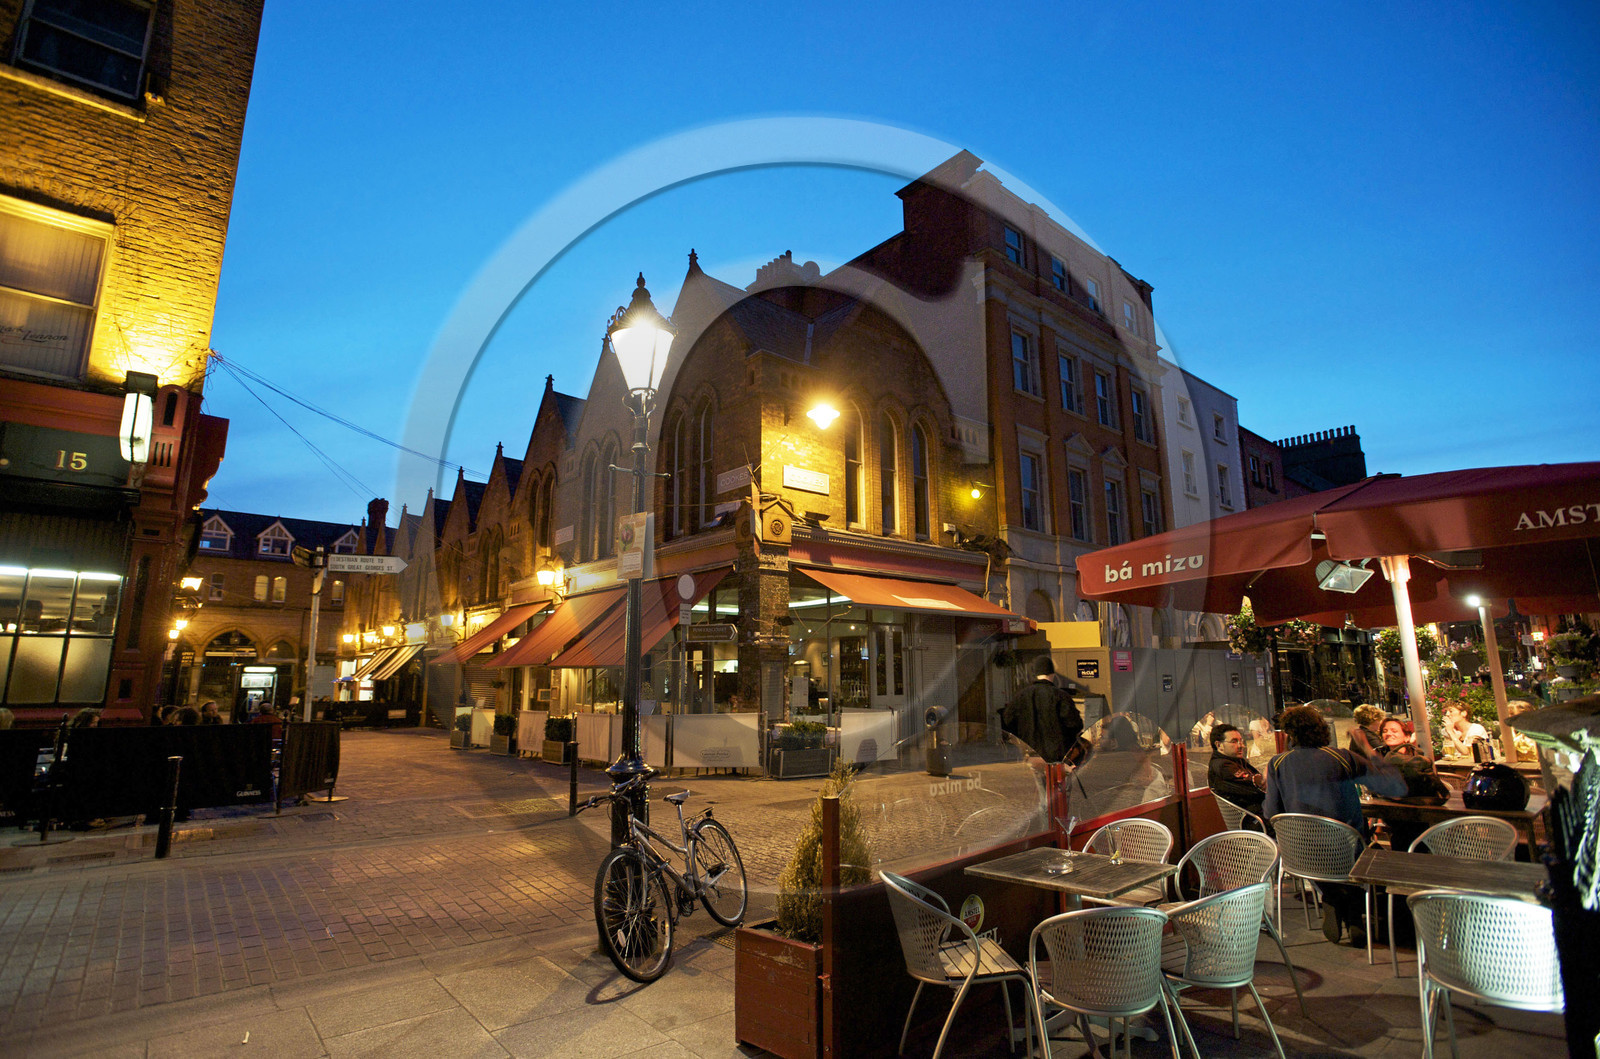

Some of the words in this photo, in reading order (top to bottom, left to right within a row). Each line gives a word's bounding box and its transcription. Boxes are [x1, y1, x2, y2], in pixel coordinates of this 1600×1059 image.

[56, 450, 88, 471] 15
[1105, 560, 1133, 583] bá
[1142, 554, 1204, 577] mizu
